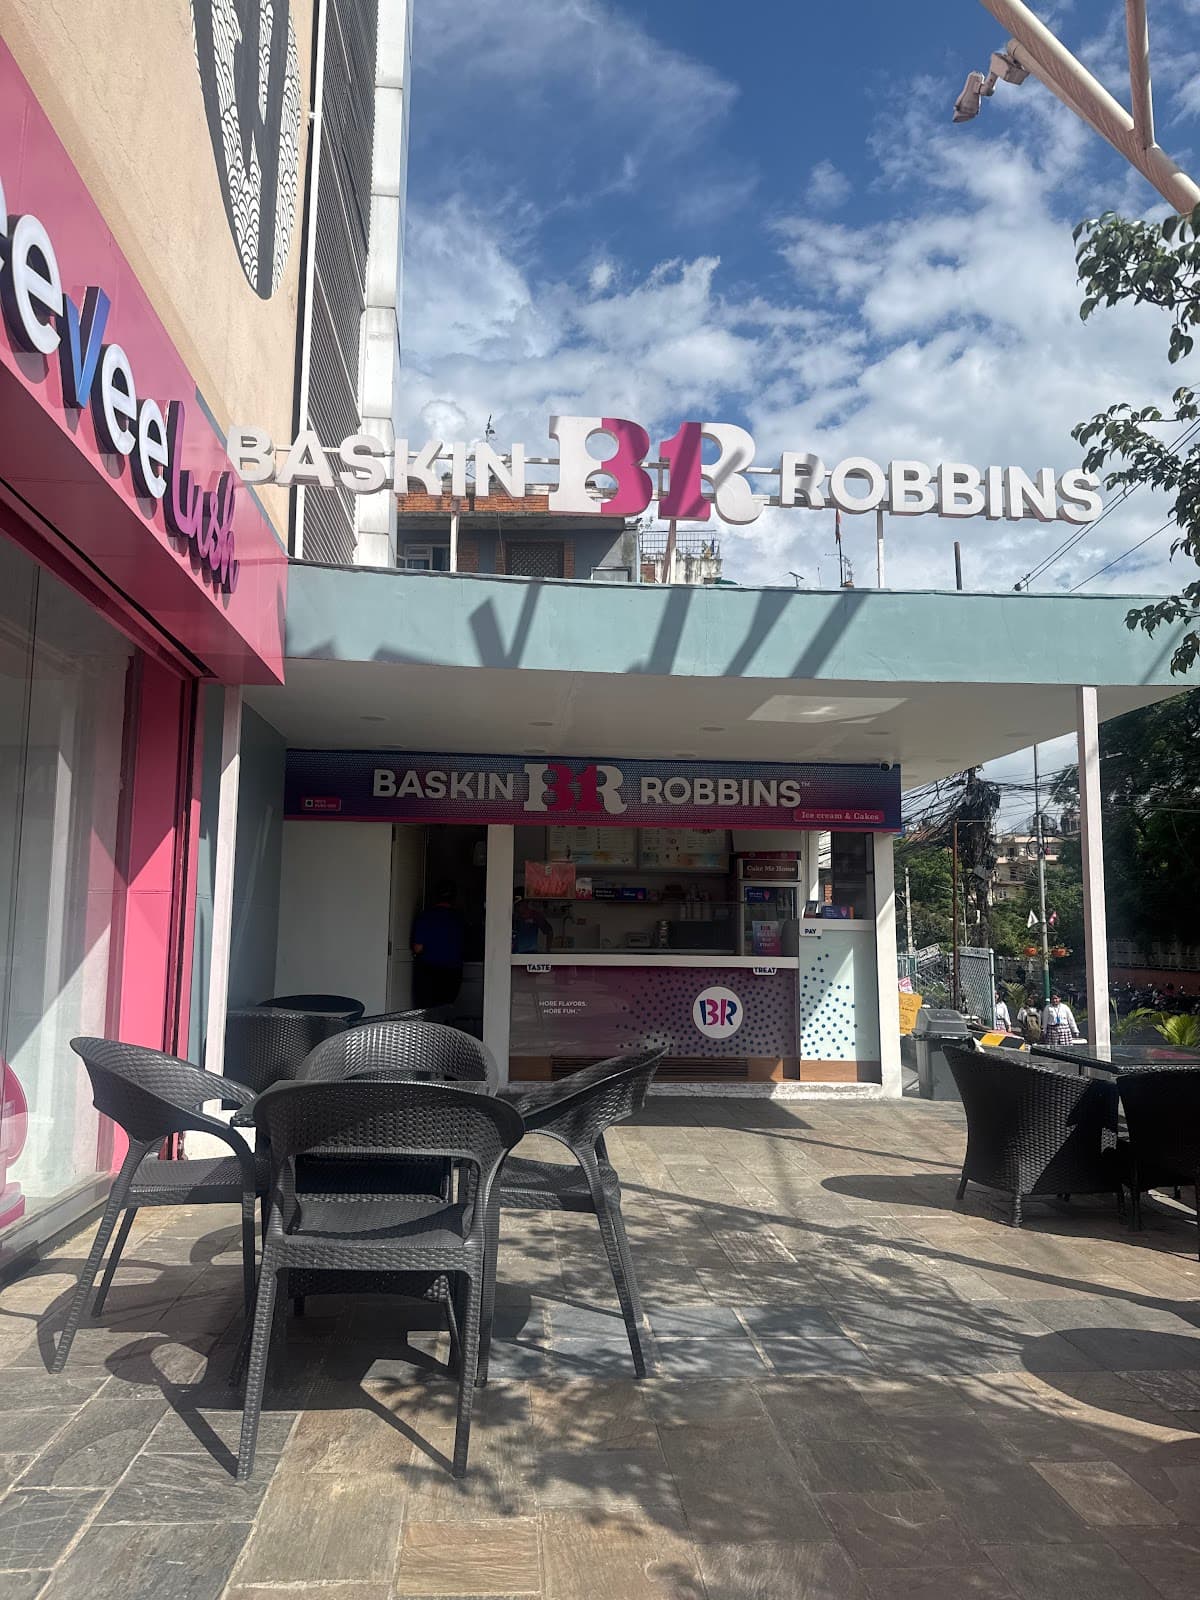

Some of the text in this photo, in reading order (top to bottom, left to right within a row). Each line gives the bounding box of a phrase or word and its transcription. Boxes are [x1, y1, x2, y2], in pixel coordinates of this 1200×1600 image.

[226, 424, 527, 498] BASKIN
[780, 451, 1104, 524] ROBBINS
[372, 768, 515, 800] BASKIN
[801, 811, 879, 820] Ice cream & Cakes
[754, 966, 777, 974] TREAT
